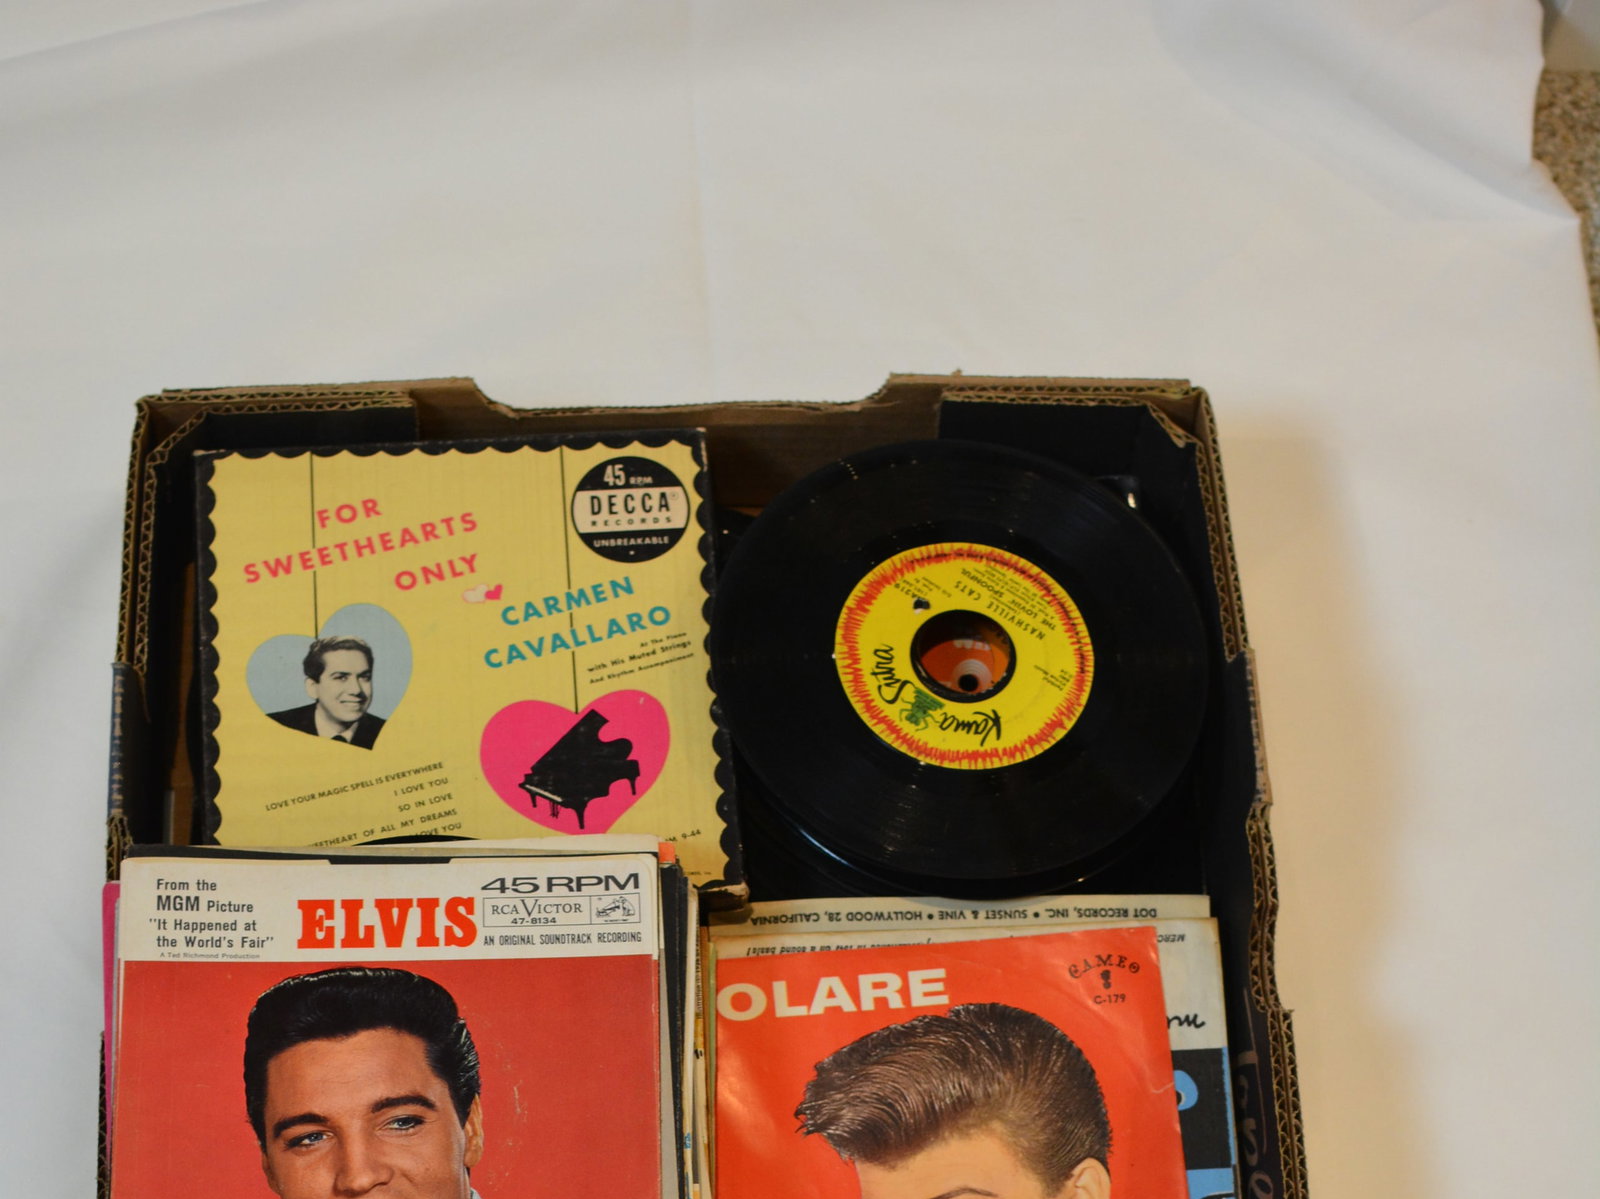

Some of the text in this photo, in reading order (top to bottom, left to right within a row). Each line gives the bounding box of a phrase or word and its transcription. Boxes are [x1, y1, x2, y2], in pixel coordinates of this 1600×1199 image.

[603, 464, 654, 486] 45 RPM
[316, 499, 382, 529] FOR
[590, 491, 671, 516] DECCA
[590, 517, 672, 527] RECORDS
[243, 512, 478, 584] SWEETHEARTS
[593, 536, 670, 548] UNBREAKABLE
[394, 553, 478, 591] ONLY
[961, 568, 1005, 598] SPOONFUL
[501, 576, 635, 626] CARMEN
[955, 581, 981, 601] CATS
[986, 603, 1046, 641] NASHVILLE
[1041, 619, 1057, 631] THE
[483, 605, 671, 669] CAVALLARO
[650, 637, 664, 645] The
[587, 640, 692, 673] with His Muted Strings
[589, 653, 694, 685] And Rhythm Accompaniment
[870, 644, 1002, 747] Kama Sutra
[266, 761, 444, 811] LOVE YOUR MAGIC SPELL IS EVERYWHERE
[402, 777, 449, 795] LOVE YOU
[398, 792, 453, 812] SO IN LOVE
[363, 828, 375, 837] OF
[381, 824, 396, 834] ALL
[400, 818, 415, 828] MY
[420, 808, 458, 824] DREAMS
[442, 822, 462, 832] YOU
[157, 879, 217, 891] From the
[480, 872, 640, 894] 45 RPM
[157, 895, 254, 913] MGM Picture
[491, 904, 520, 915] RCA
[149, 918, 257, 934] "It Happened at
[297, 897, 478, 949] ELVIS
[511, 917, 557, 925] 47-8134
[751, 907, 1157, 926] DOT RECORDS, INC. SUNSET & VINE HOLLYWOOD 28, CALIFORNIA
[157, 936, 274, 949] the World's Fair"
[483, 931, 642, 946] AN ORIGINAL SOUNDTRACK RECORDING
[1068, 954, 1140, 979] CAMEO
[716, 968, 949, 1021] OLARE
[1093, 994, 1126, 1004] C-179
